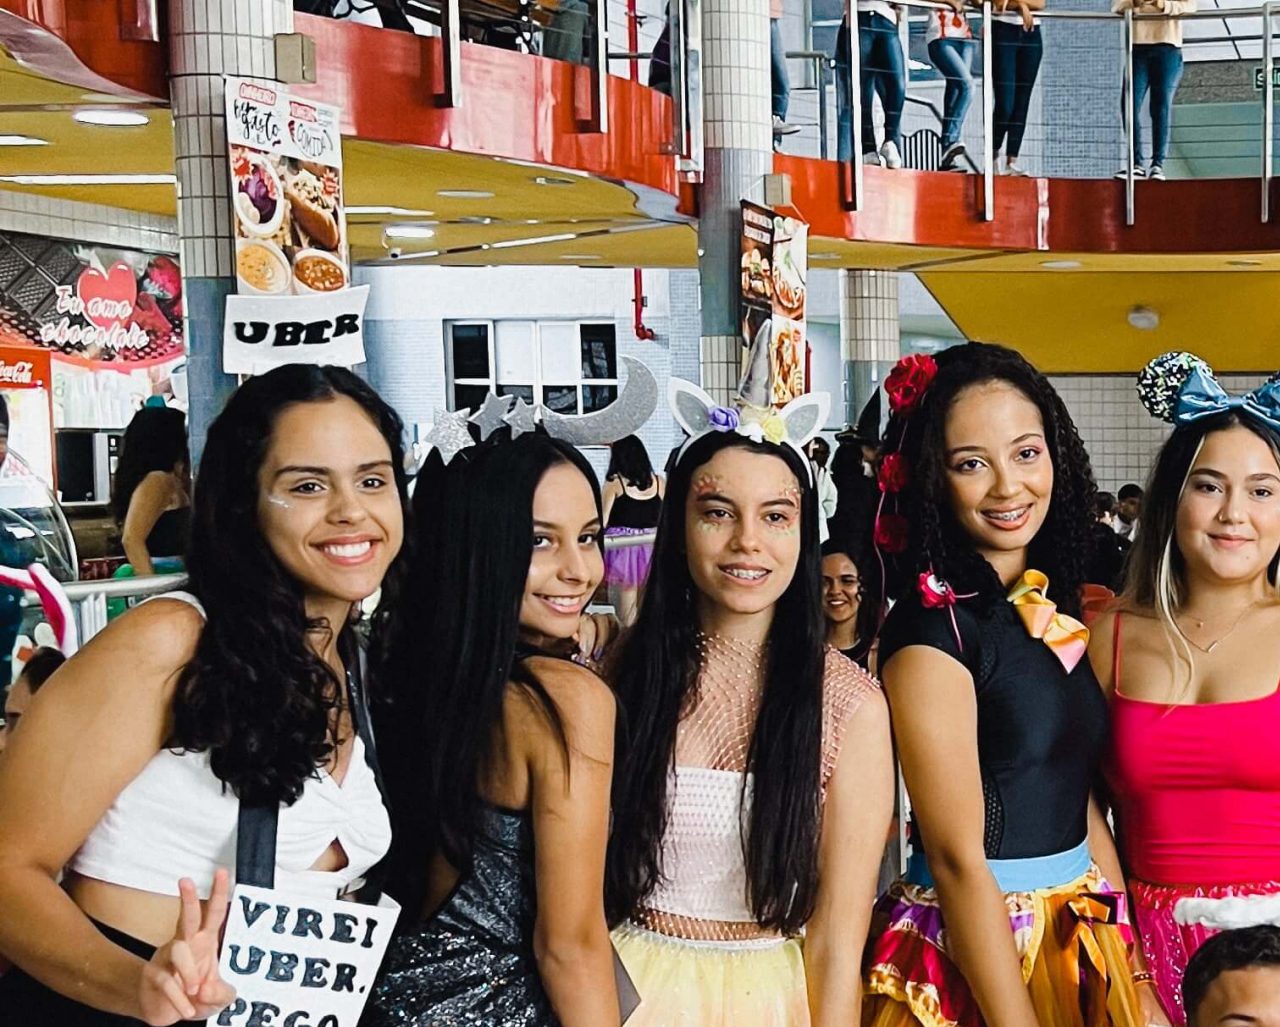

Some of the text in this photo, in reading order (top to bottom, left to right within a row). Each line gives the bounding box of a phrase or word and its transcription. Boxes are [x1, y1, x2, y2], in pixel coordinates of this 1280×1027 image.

[55, 284, 133, 320] Eu amo
[40, 316, 150, 350] chocolate
[233, 314, 360, 347] UBER
[239, 895, 378, 949] VIREI
